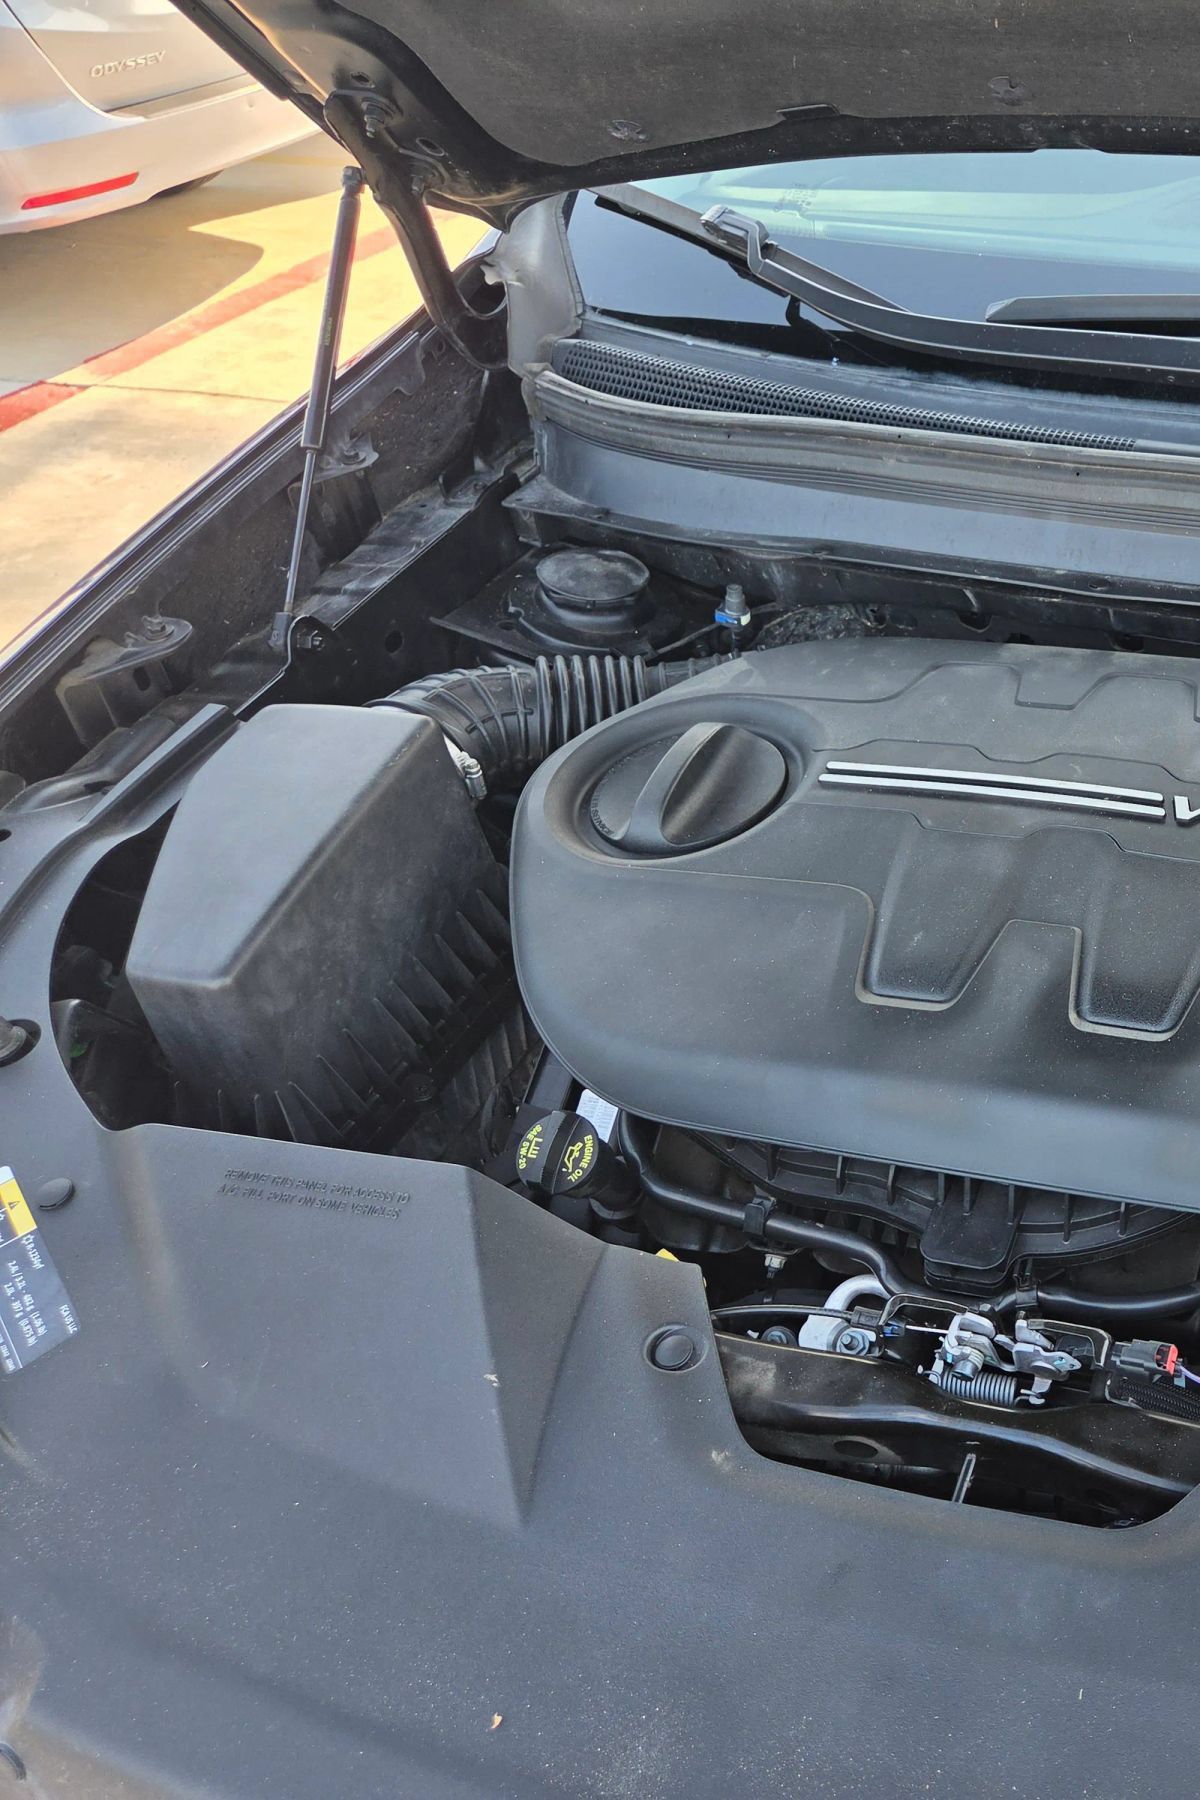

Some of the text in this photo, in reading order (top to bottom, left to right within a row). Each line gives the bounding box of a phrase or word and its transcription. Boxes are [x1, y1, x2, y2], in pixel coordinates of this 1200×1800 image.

[90, 50, 166, 78] ODYSSEY
[518, 1124, 542, 1170] SAE 5W-20
[568, 1134, 594, 1182] ENGINE OIL
[225, 1168, 410, 1204] REMOVE THIS PANEL FOR ACCESS TO
[267, 1191, 298, 1204] PORT
[298, 1196, 316, 1208] ON
[314, 1198, 346, 1212] SOME
[351, 1202, 401, 1220] VEHICLES
[59, 1304, 71, 1317] FCA
